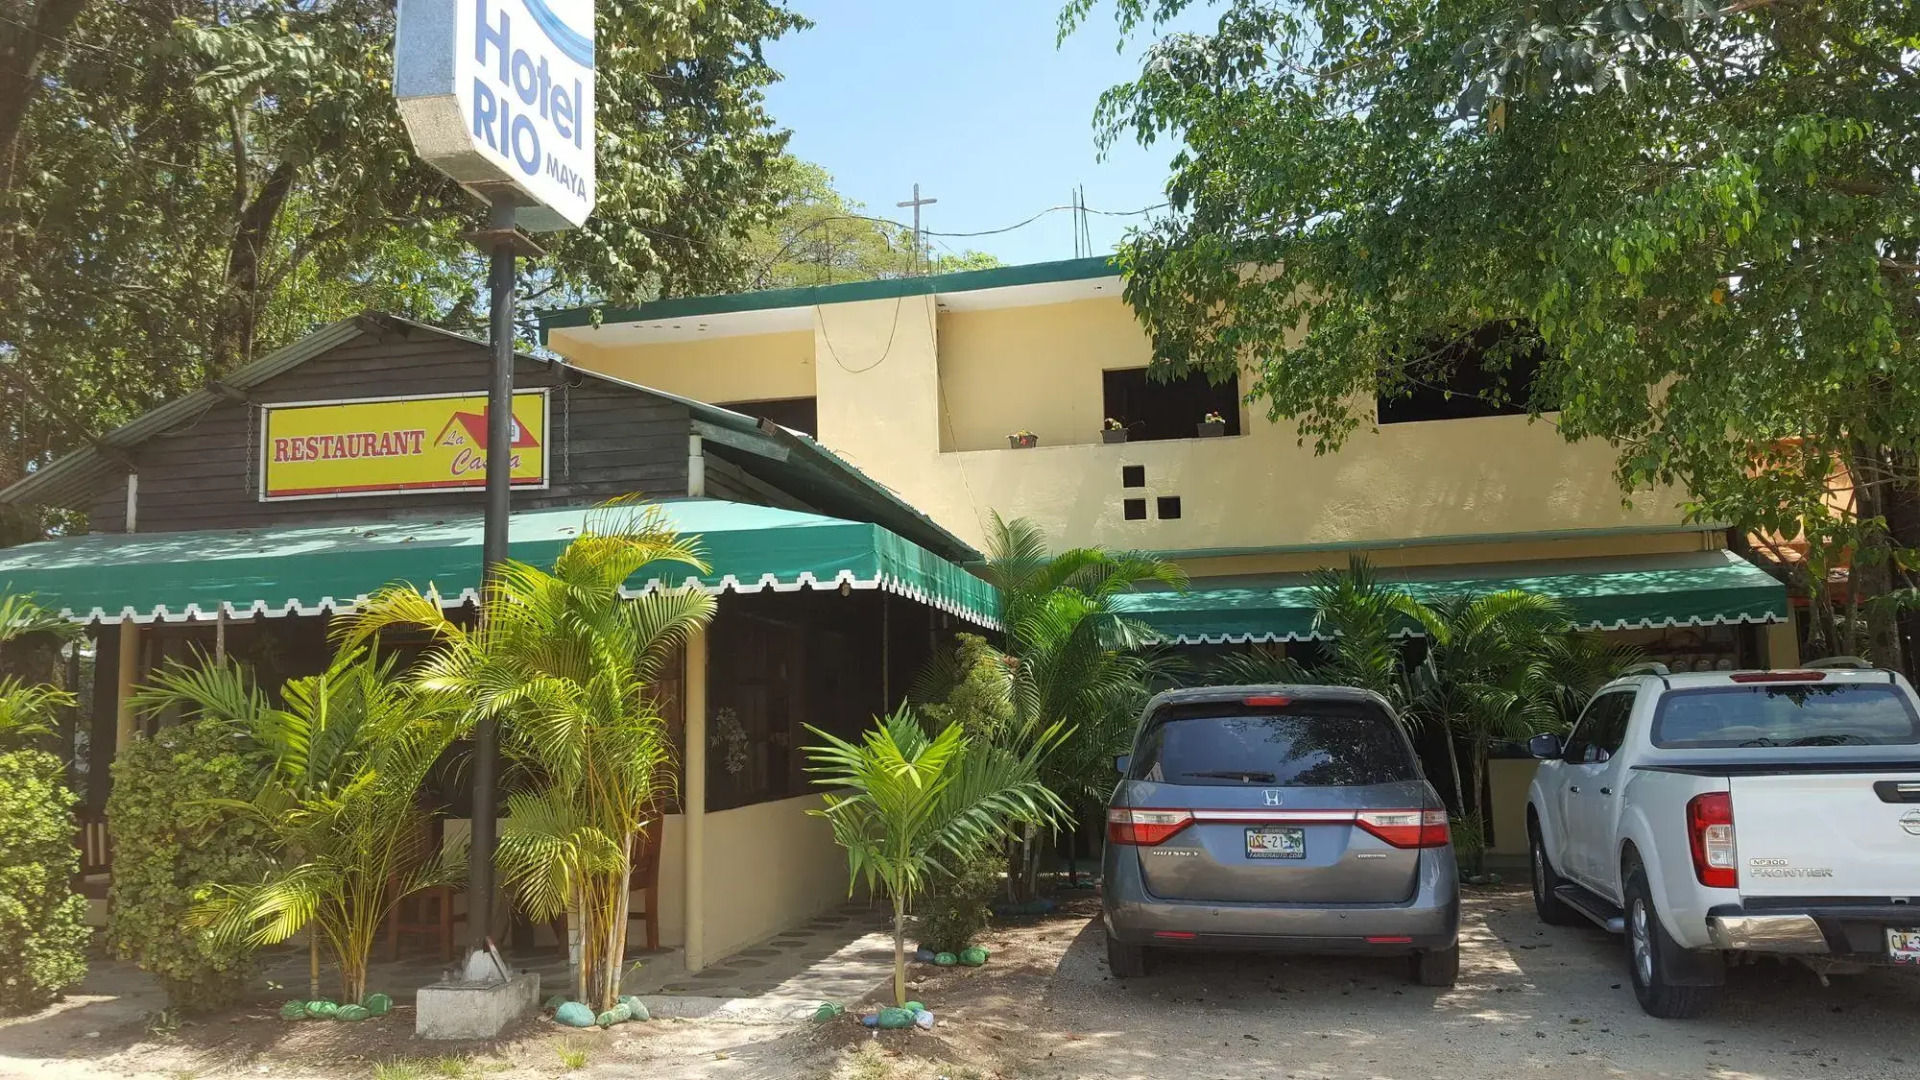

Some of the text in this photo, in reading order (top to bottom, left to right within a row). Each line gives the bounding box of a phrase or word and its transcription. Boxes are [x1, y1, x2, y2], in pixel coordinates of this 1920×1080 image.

[474, 0, 583, 150] Hotel
[473, 76, 587, 202] RIO MAYA
[273, 430, 425, 463] RESTAURANT
[442, 430, 464, 446] La
[1751, 868, 1833, 878] FRONTIER
